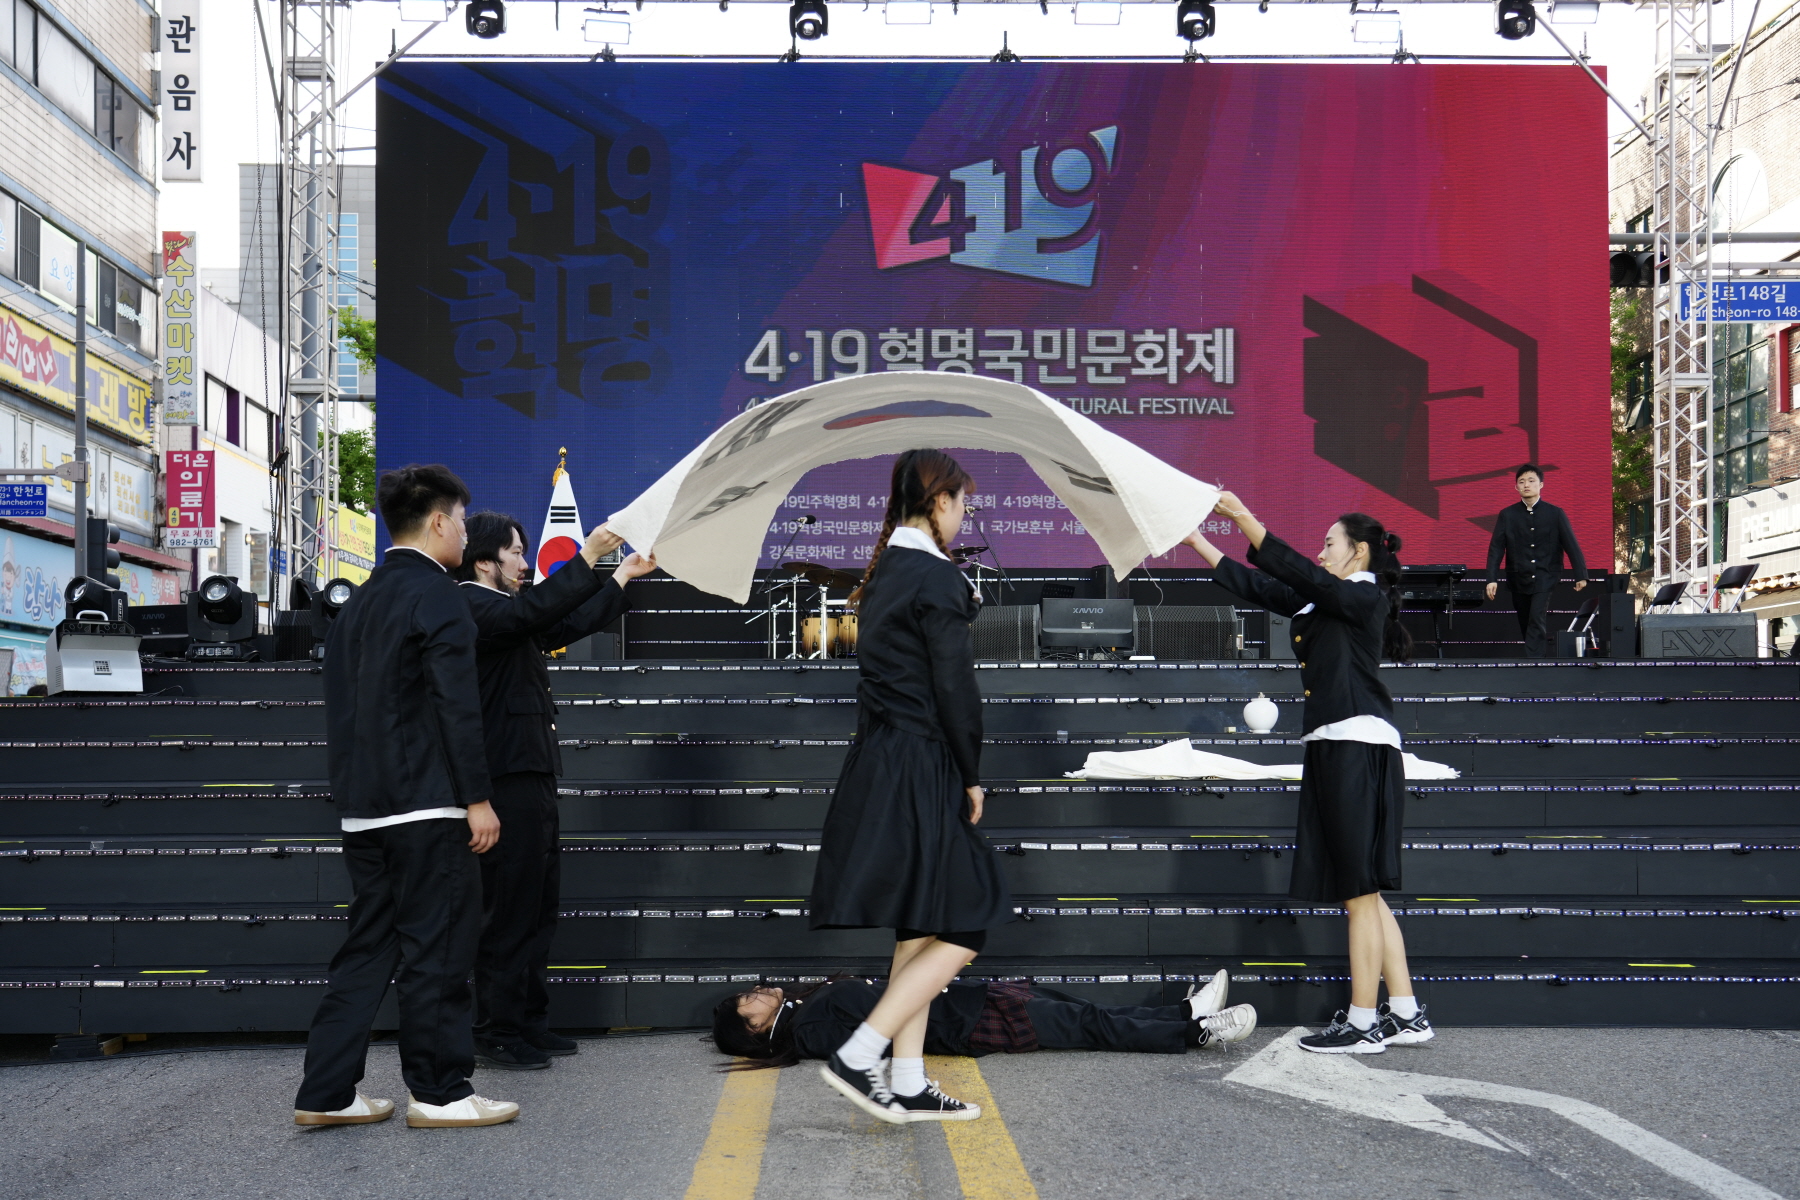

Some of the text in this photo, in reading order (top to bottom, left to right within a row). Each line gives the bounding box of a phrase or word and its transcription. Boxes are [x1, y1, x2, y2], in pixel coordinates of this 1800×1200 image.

[166, 14, 197, 171] 관음사
[165, 255, 195, 386] 수산마켓
[68, 350, 148, 435] 노래방
[1055, 397, 1234, 414] TURAL FESTIVAL
[42, 444, 92, 498] 노래
[13, 486, 44, 497] 한천로
[180, 471, 202, 527] 의료기
[170, 529, 213, 538] 무료체험
[991, 520, 1054, 535] 국가보훈부
[769, 545, 845, 560] 강북문화재단
